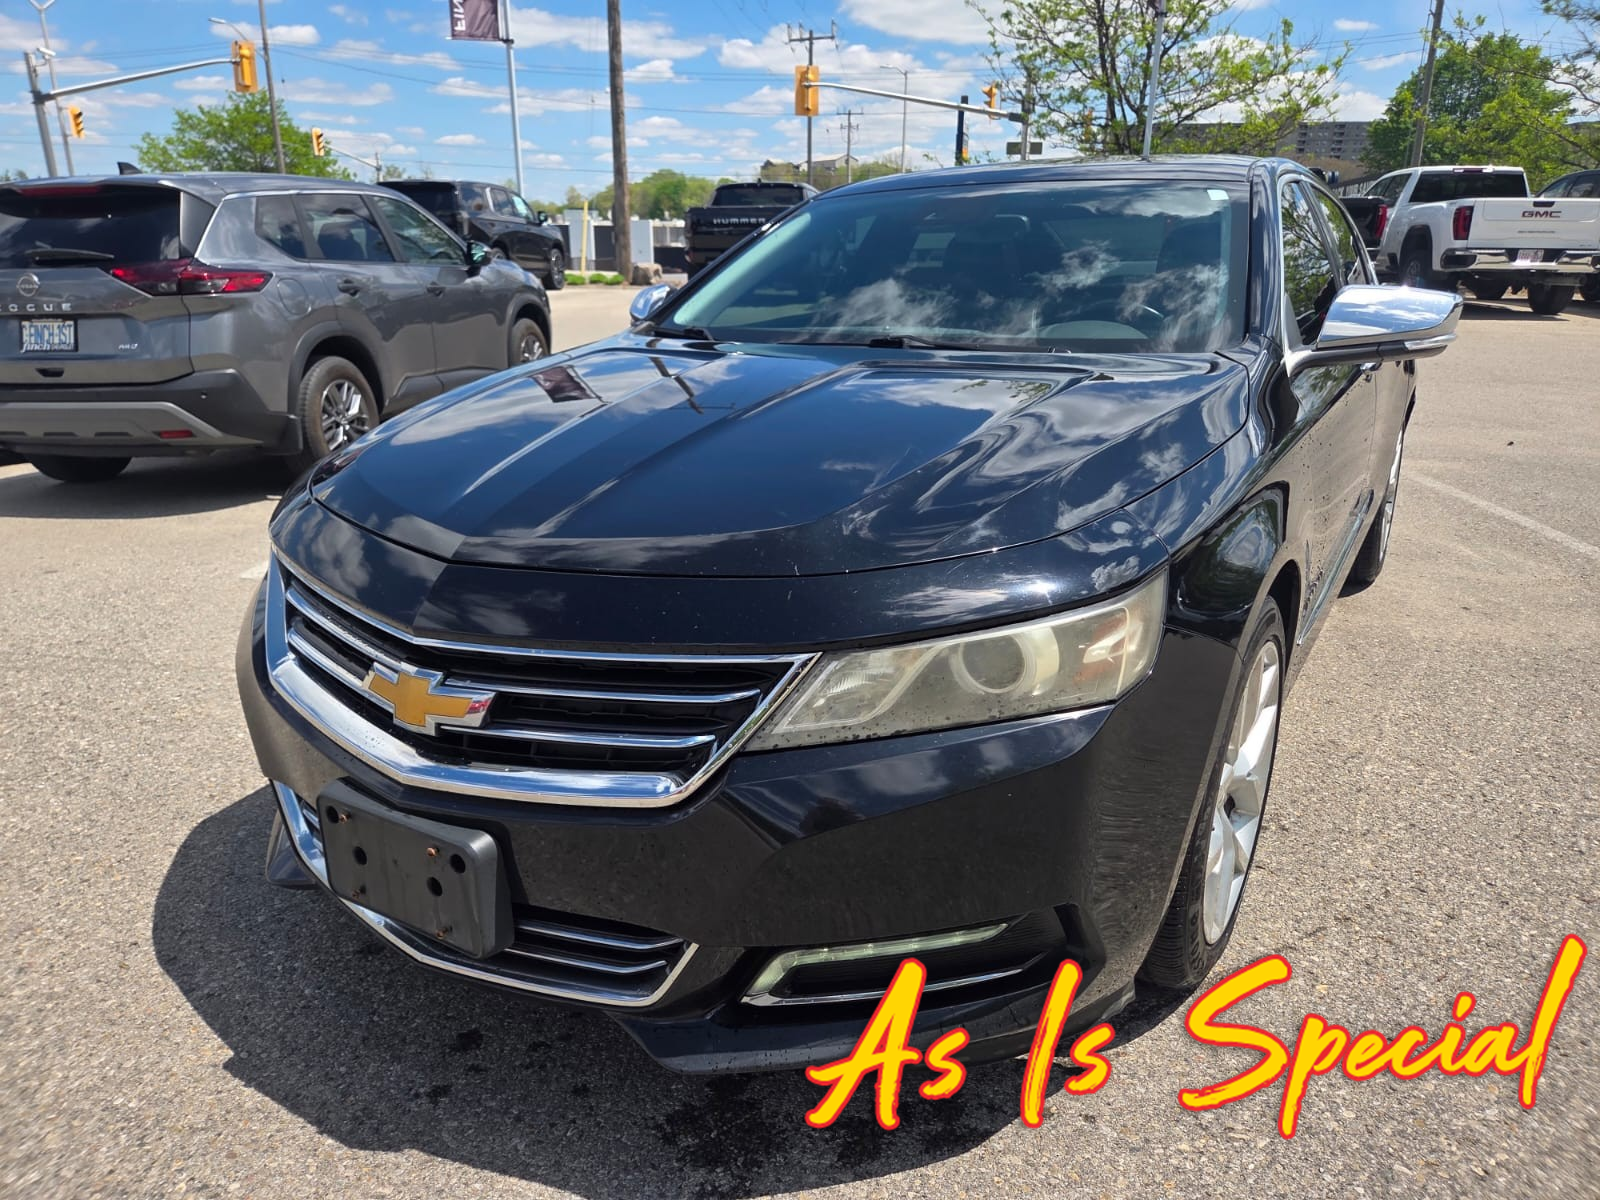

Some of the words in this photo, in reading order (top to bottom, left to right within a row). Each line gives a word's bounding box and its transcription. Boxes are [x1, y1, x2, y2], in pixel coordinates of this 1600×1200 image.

[1521, 210, 1562, 218] GMC
[713, 217, 766, 225] HUMMER
[0, 303, 72, 312] OGUE
